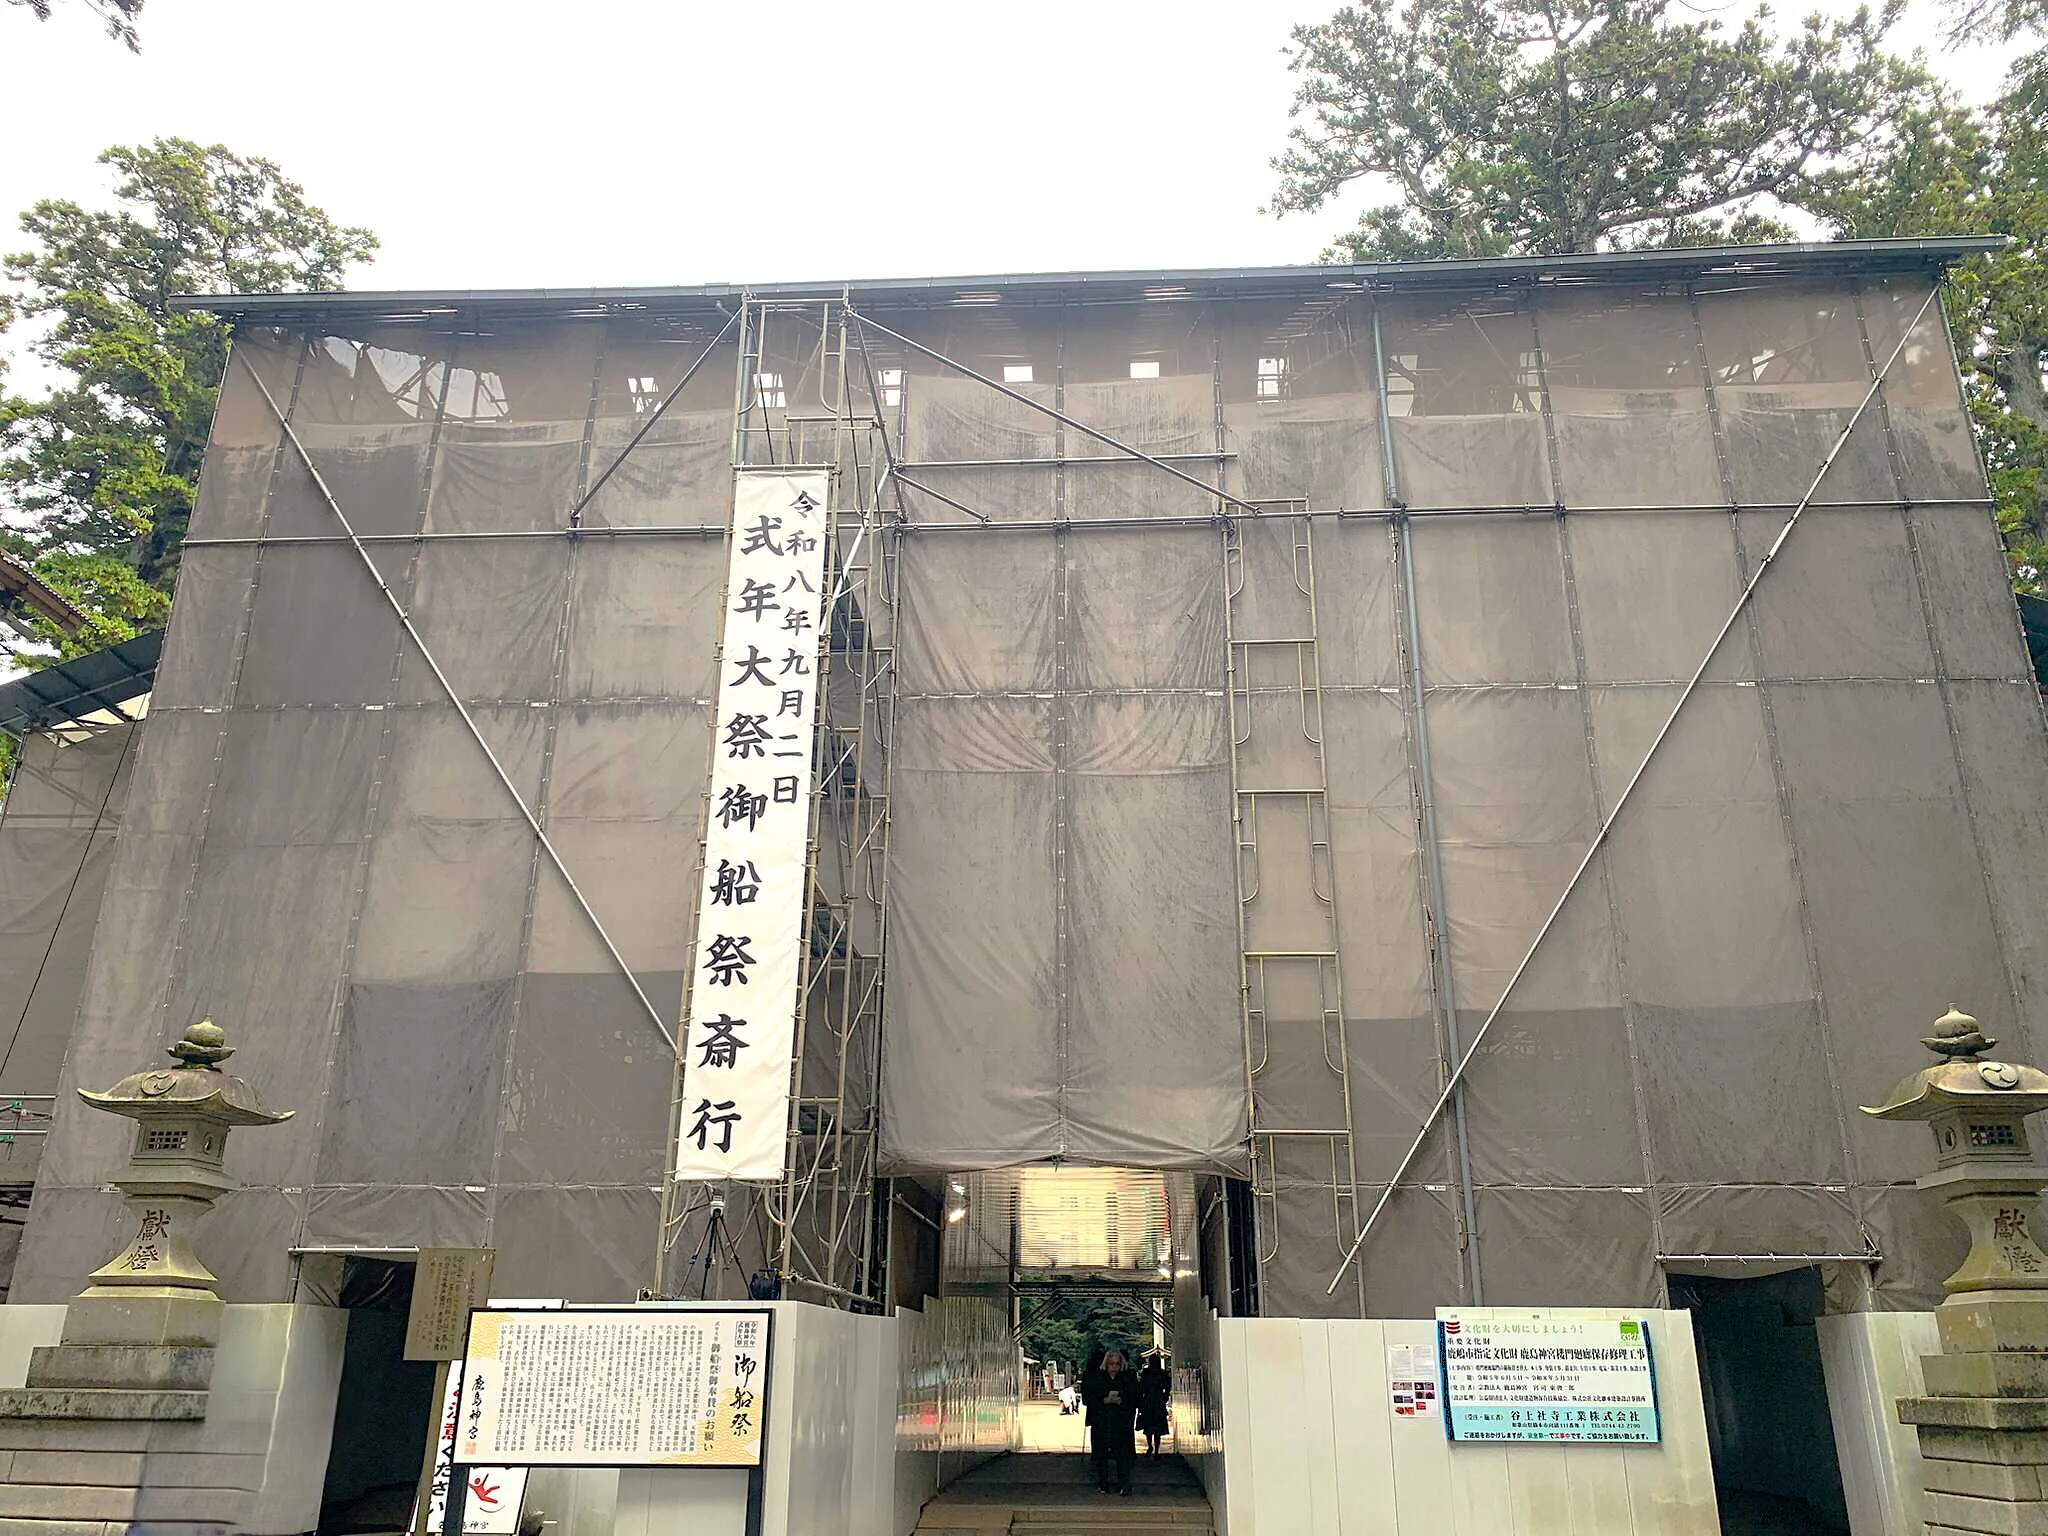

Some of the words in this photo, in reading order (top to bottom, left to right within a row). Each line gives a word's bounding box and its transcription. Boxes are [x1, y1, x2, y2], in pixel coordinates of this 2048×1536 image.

[771, 490, 821, 804] 令和八年九月二日
[686, 514, 785, 1154] 式年大祭御船祭斎行
[1447, 1337, 1490, 1346] 重要文化財
[1447, 1347, 1518, 1360] 鹿嶋市指定文化財
[468, 1374, 485, 1440] 鹿島神宮
[729, 1352, 757, 1437] 御船祭
[1511, 1410, 1640, 1421] 谷上社寺工業株式会社
